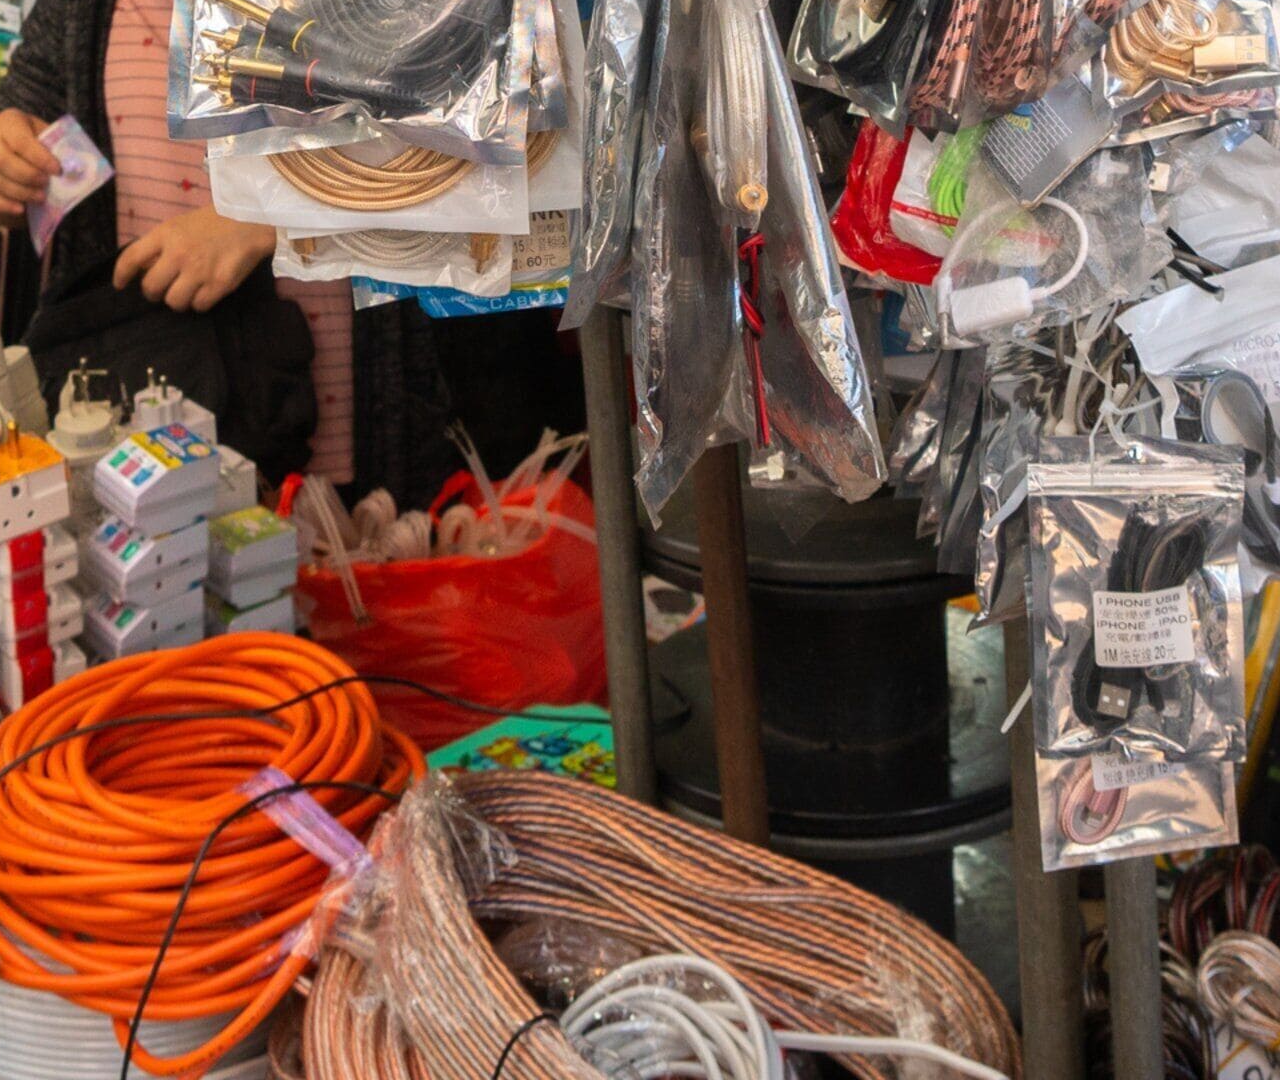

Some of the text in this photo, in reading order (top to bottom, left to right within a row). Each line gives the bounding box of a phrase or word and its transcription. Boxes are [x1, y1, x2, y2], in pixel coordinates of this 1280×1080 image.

[1106, 597, 1152, 608] PHONE
[1156, 593, 1180, 606] USB
[1096, 620, 1146, 630] IPHONE
[1104, 648, 1118, 662] 1M
